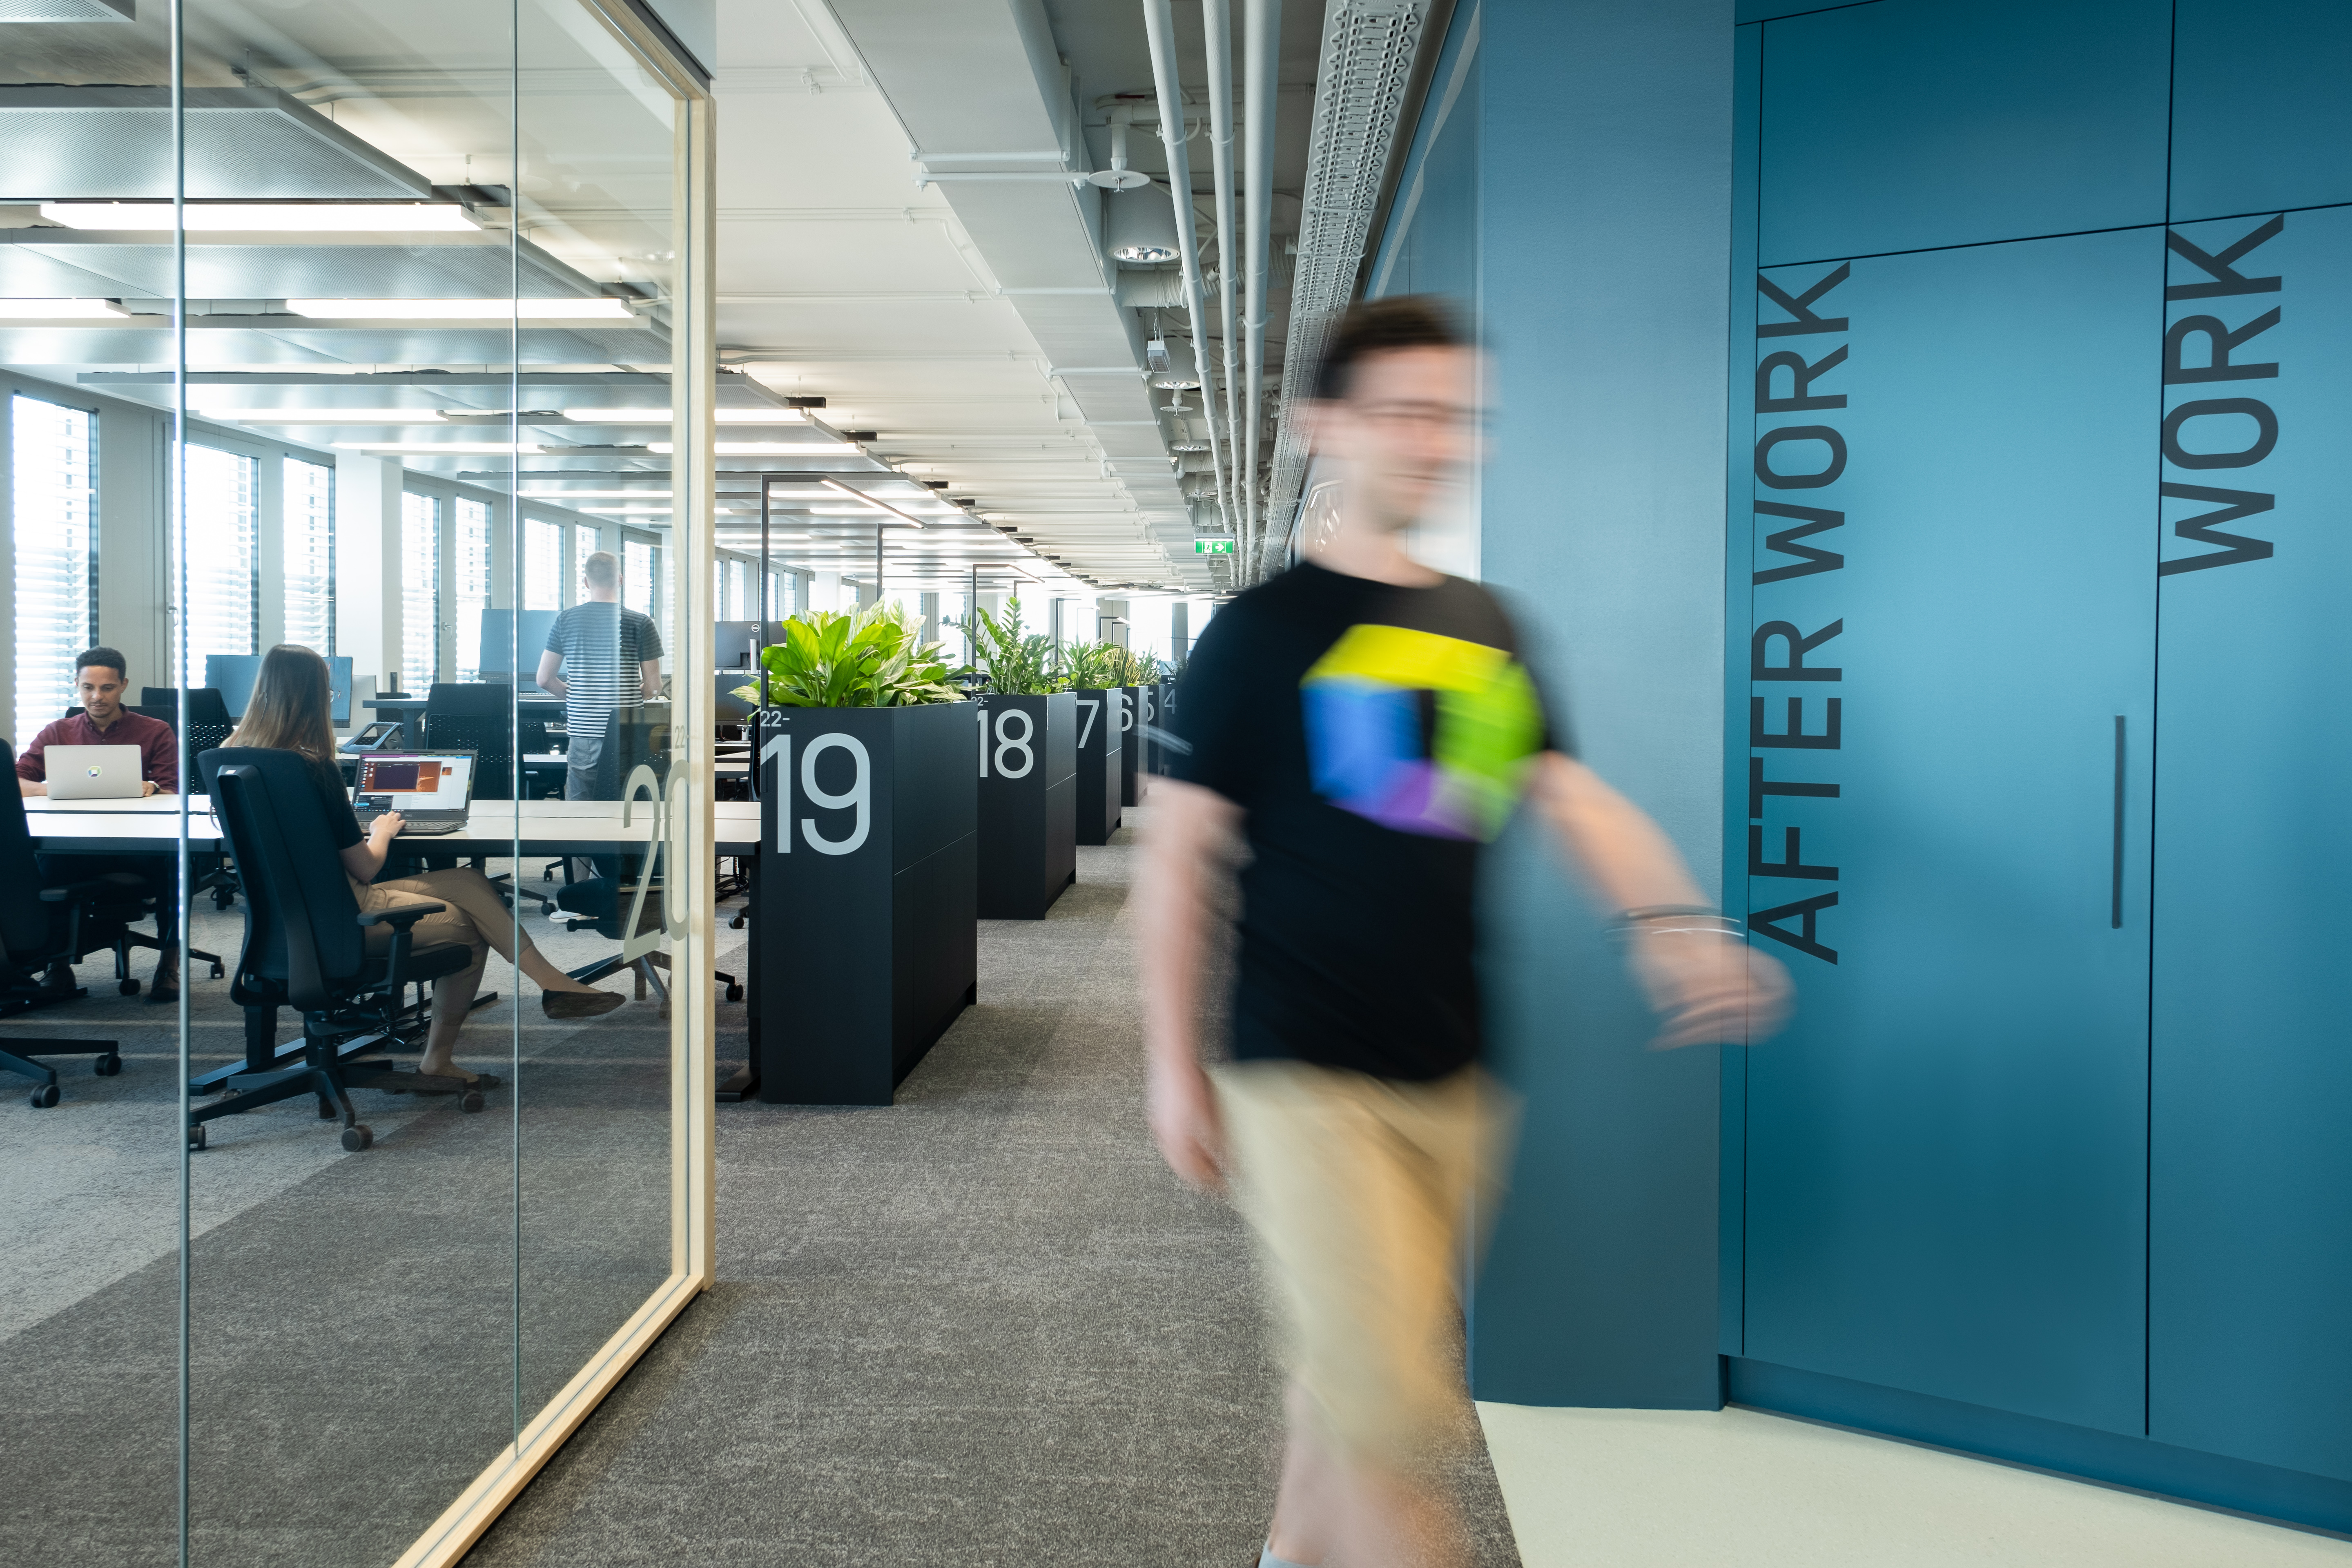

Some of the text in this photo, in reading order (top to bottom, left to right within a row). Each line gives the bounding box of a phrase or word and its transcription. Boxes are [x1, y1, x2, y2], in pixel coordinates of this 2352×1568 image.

[2159, 212, 2284, 577] WORK
[1748, 261, 1850, 966] AFTER WORK
[760, 710, 790, 727] 22-
[977, 709, 1034, 778] 18
[760, 733, 870, 855] 19
